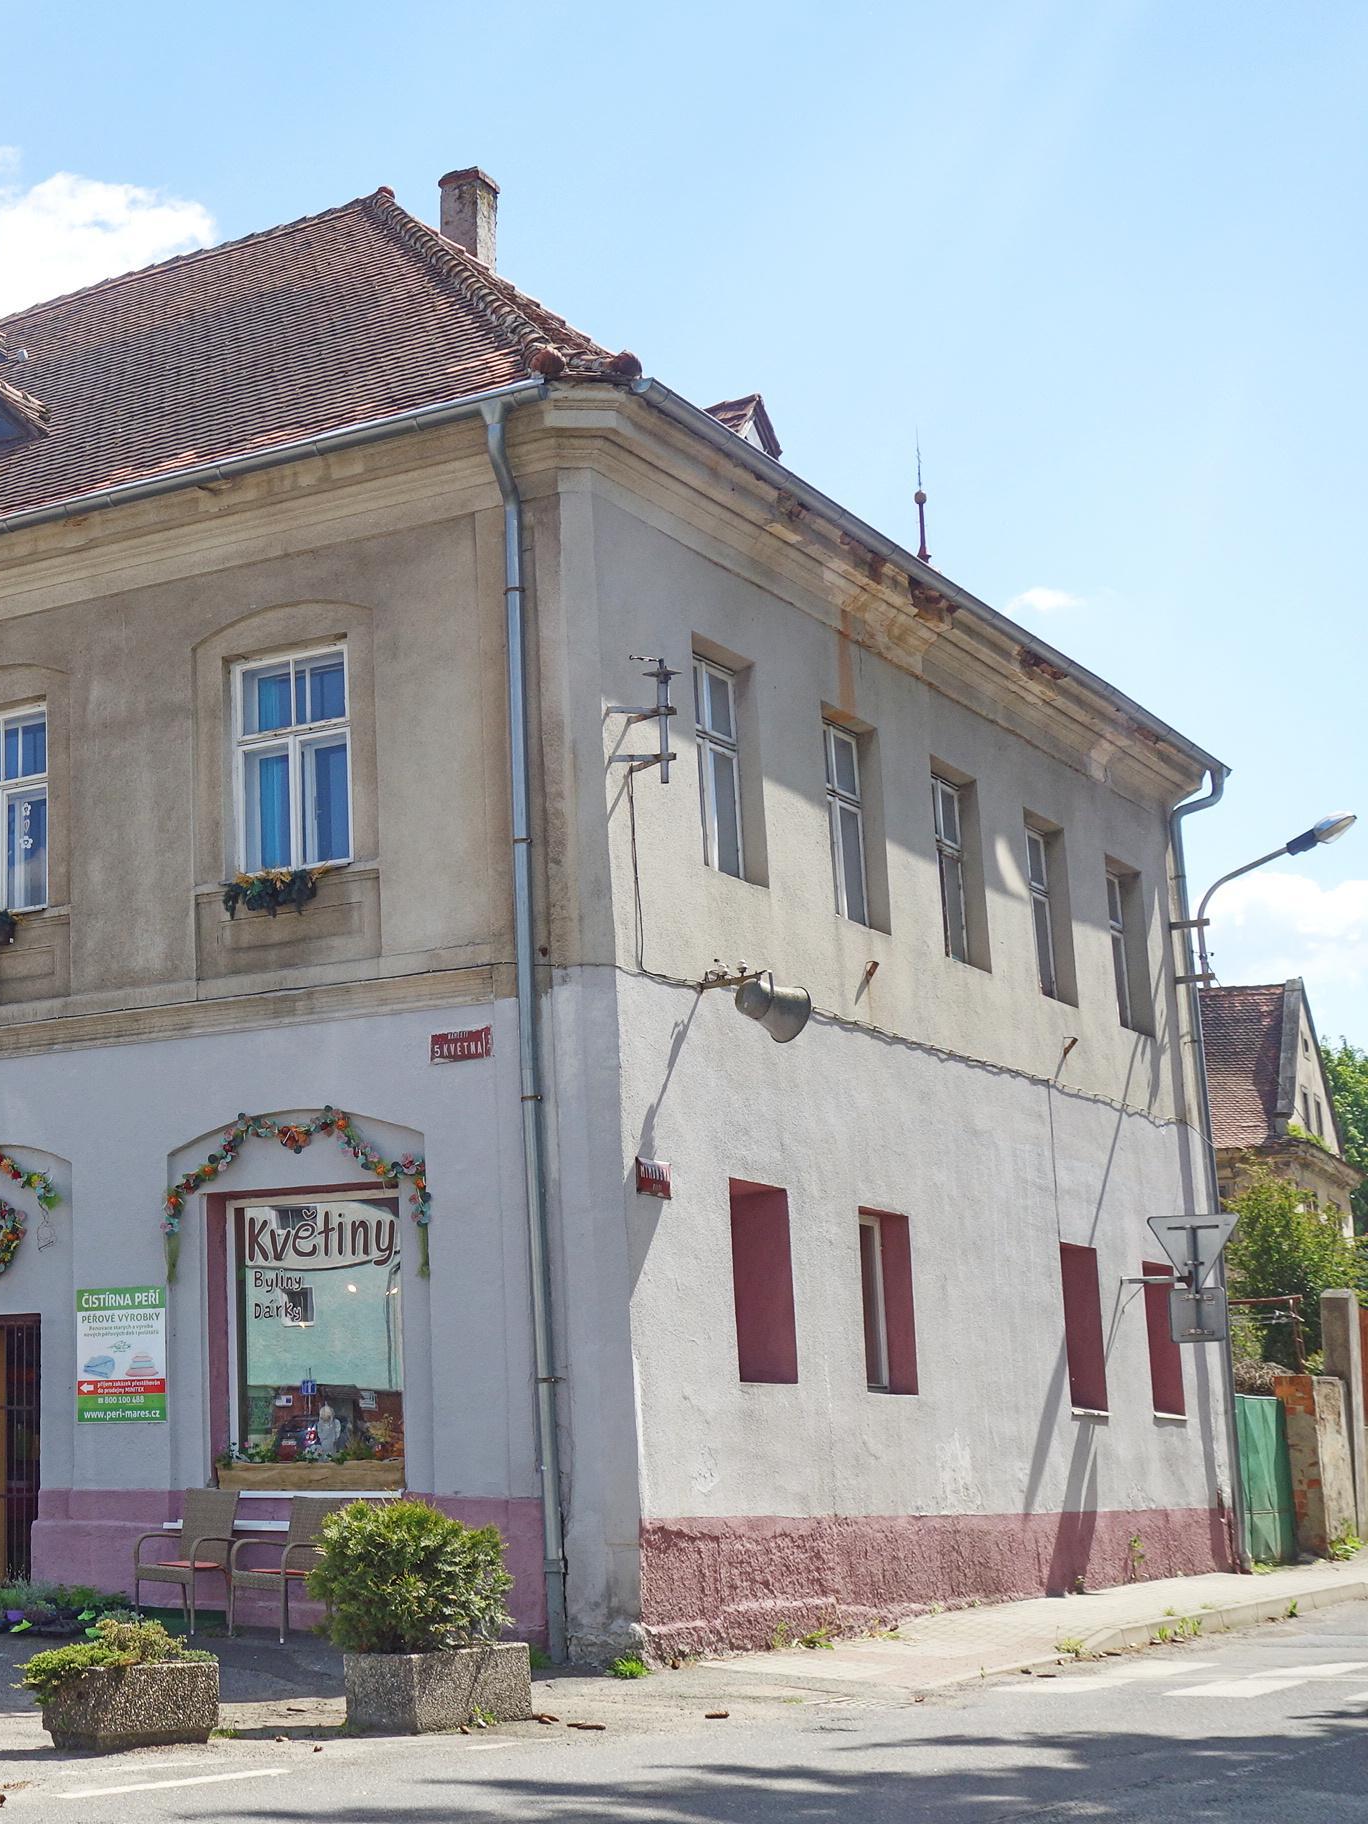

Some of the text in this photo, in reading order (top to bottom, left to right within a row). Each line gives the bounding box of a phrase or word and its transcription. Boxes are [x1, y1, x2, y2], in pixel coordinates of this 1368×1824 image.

[434, 1044, 441, 1057] 5
[248, 1210, 395, 1266] Květiny
[254, 1270, 302, 1293] Byliny
[81, 1289, 161, 1308] ČISTÍRNA PEŘÍ
[117, 1312, 161, 1322] VÝROBKY
[254, 1299, 302, 1321] Dárky
[104, 1396, 117, 1404] 800
[83, 1408, 160, 1420] www.peri-mares.cz
